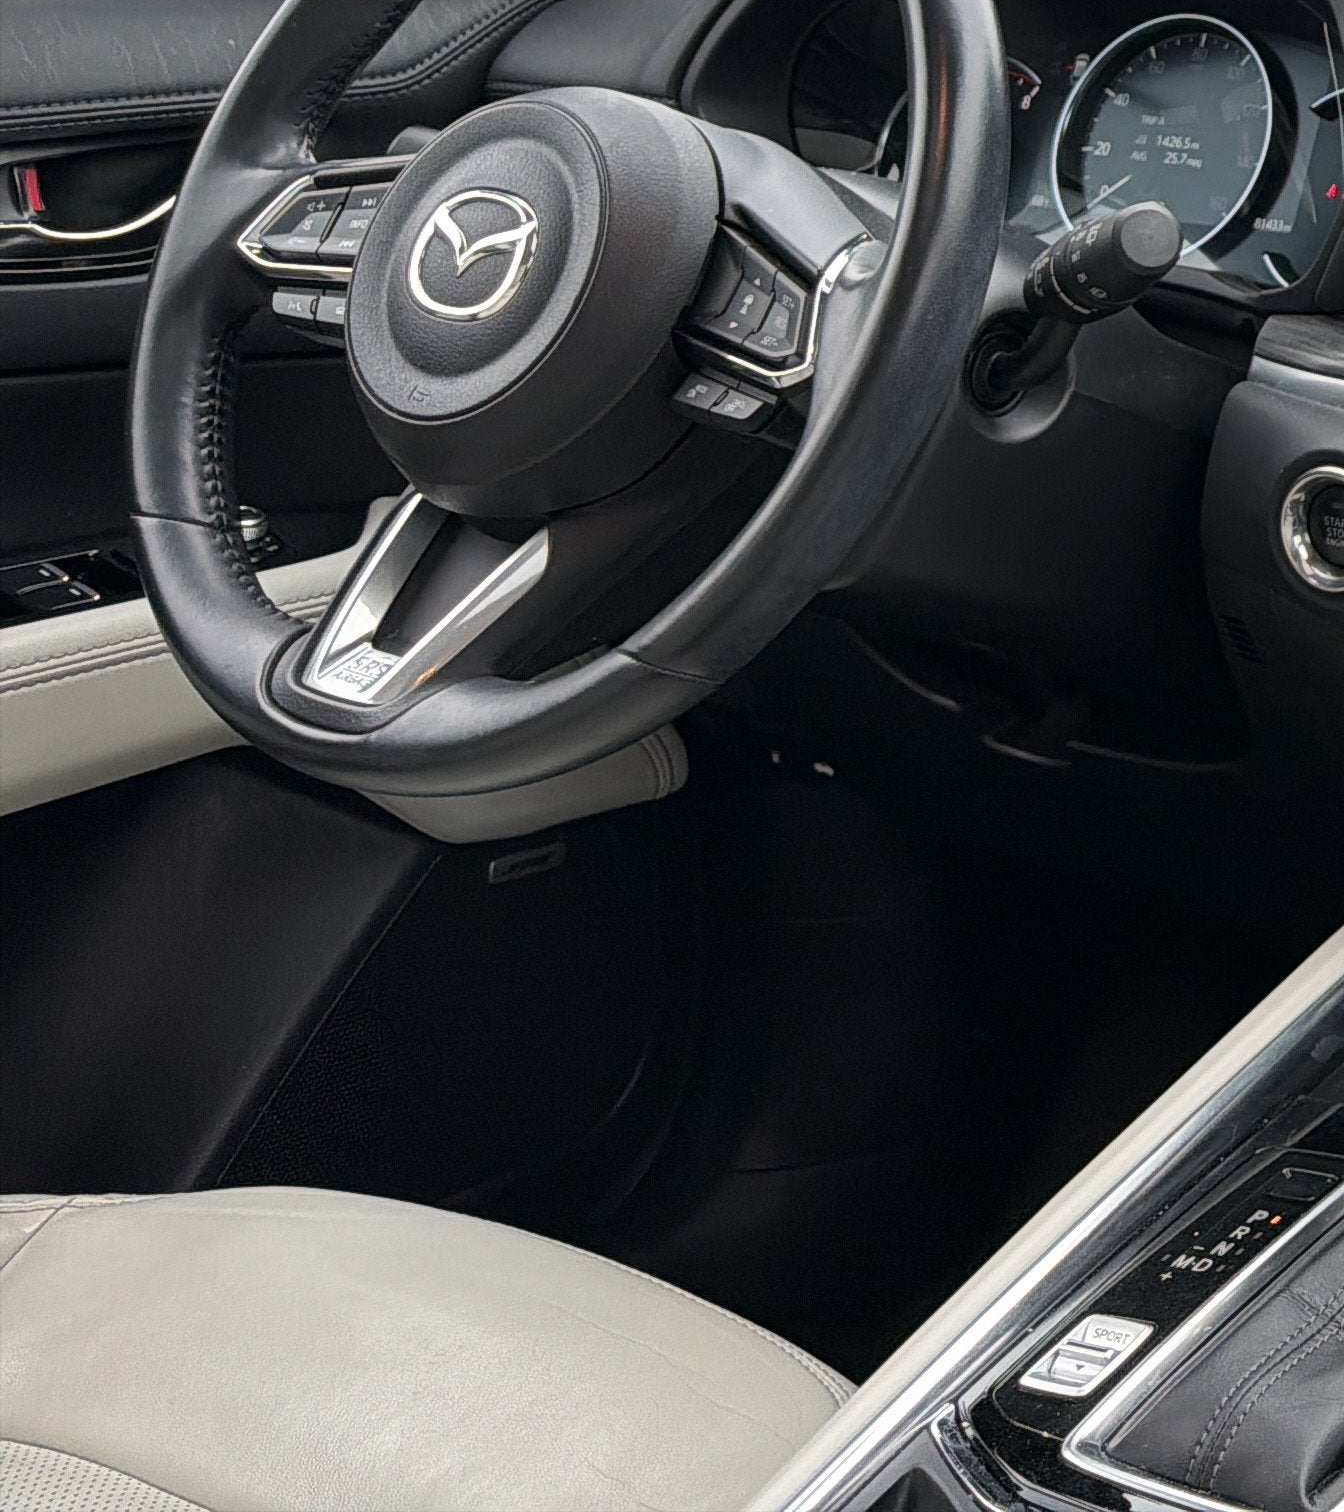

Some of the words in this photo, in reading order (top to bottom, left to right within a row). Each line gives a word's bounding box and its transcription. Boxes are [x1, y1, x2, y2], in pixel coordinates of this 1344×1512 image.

[1021, 94, 1031, 111] 8
[1114, 92, 1130, 107] 40
[1141, 115, 1158, 126] TRIP
[1159, 116, 1165, 126] A
[1093, 140, 1111, 156] 20
[349, 219, 370, 229] INFO
[1246, 1209, 1270, 1223] P
[1229, 1225, 1251, 1240] R
[1209, 1240, 1235, 1257] N
[1092, 1327, 1131, 1345] SPORT
